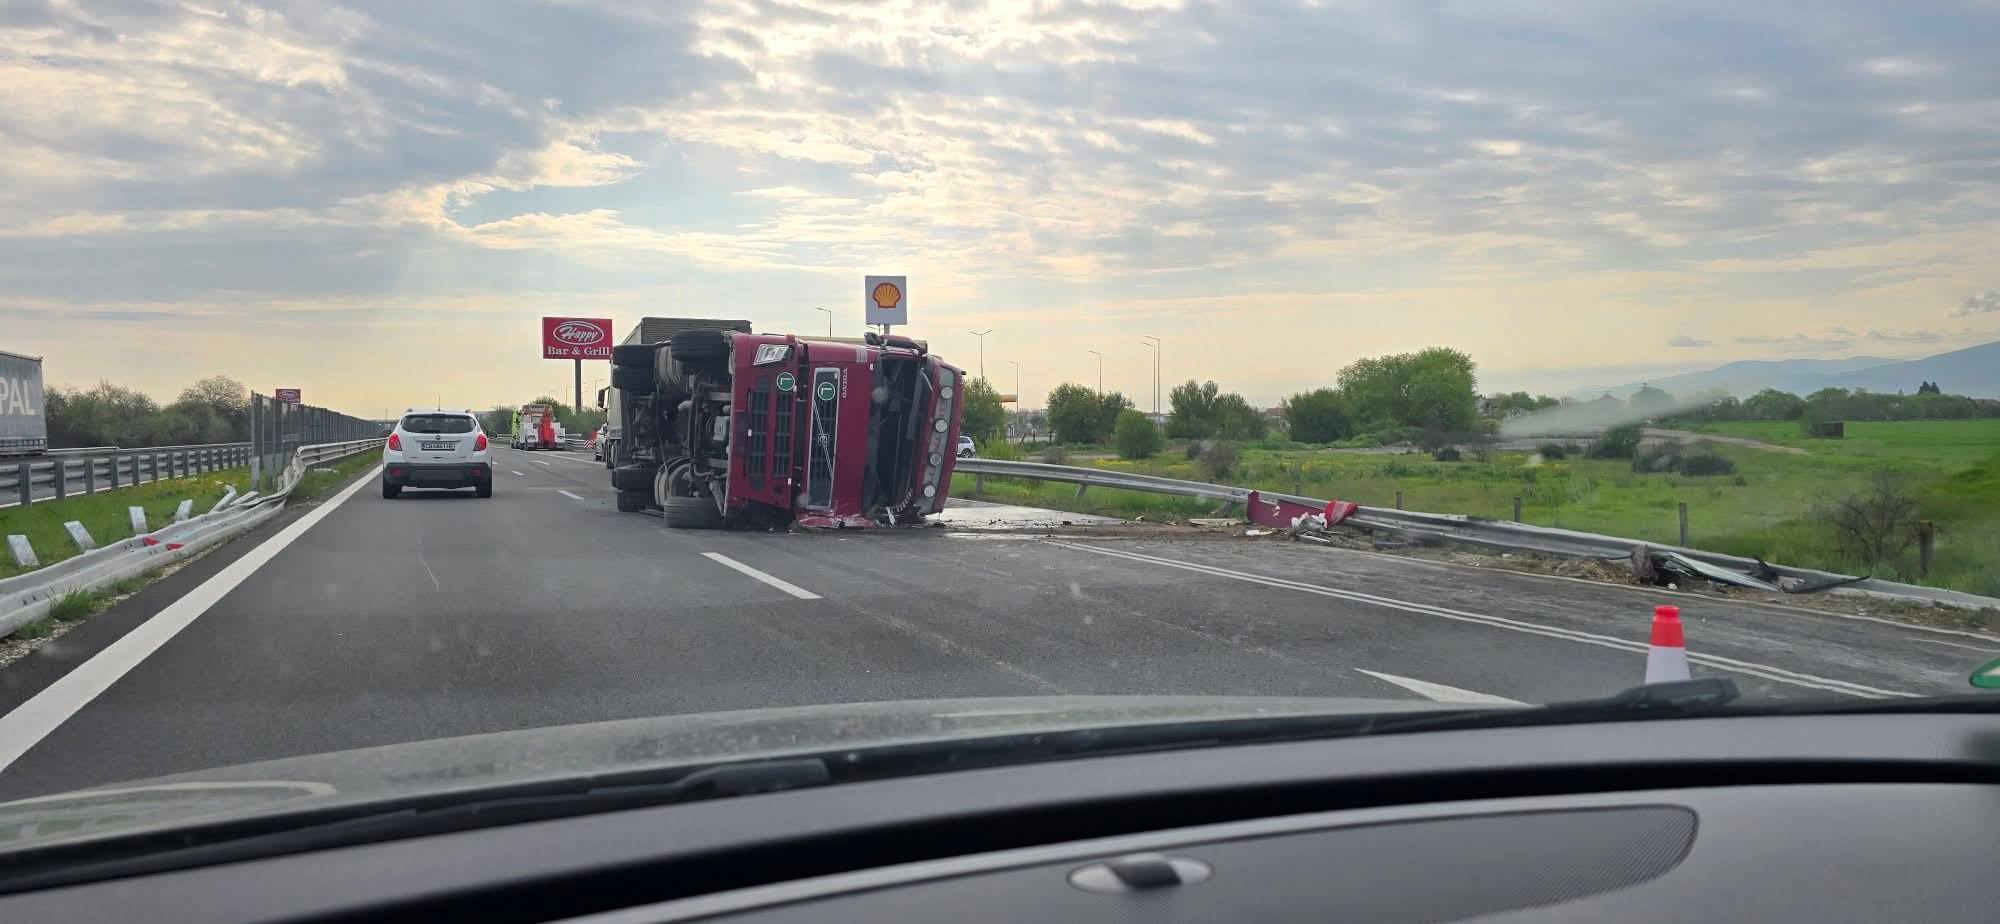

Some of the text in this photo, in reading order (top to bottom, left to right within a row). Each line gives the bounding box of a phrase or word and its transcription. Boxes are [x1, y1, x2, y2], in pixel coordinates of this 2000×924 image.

[560, 326, 598, 342] Happy
[548, 346, 610, 356] Bar & Grill
[821, 387, 832, 395] L
